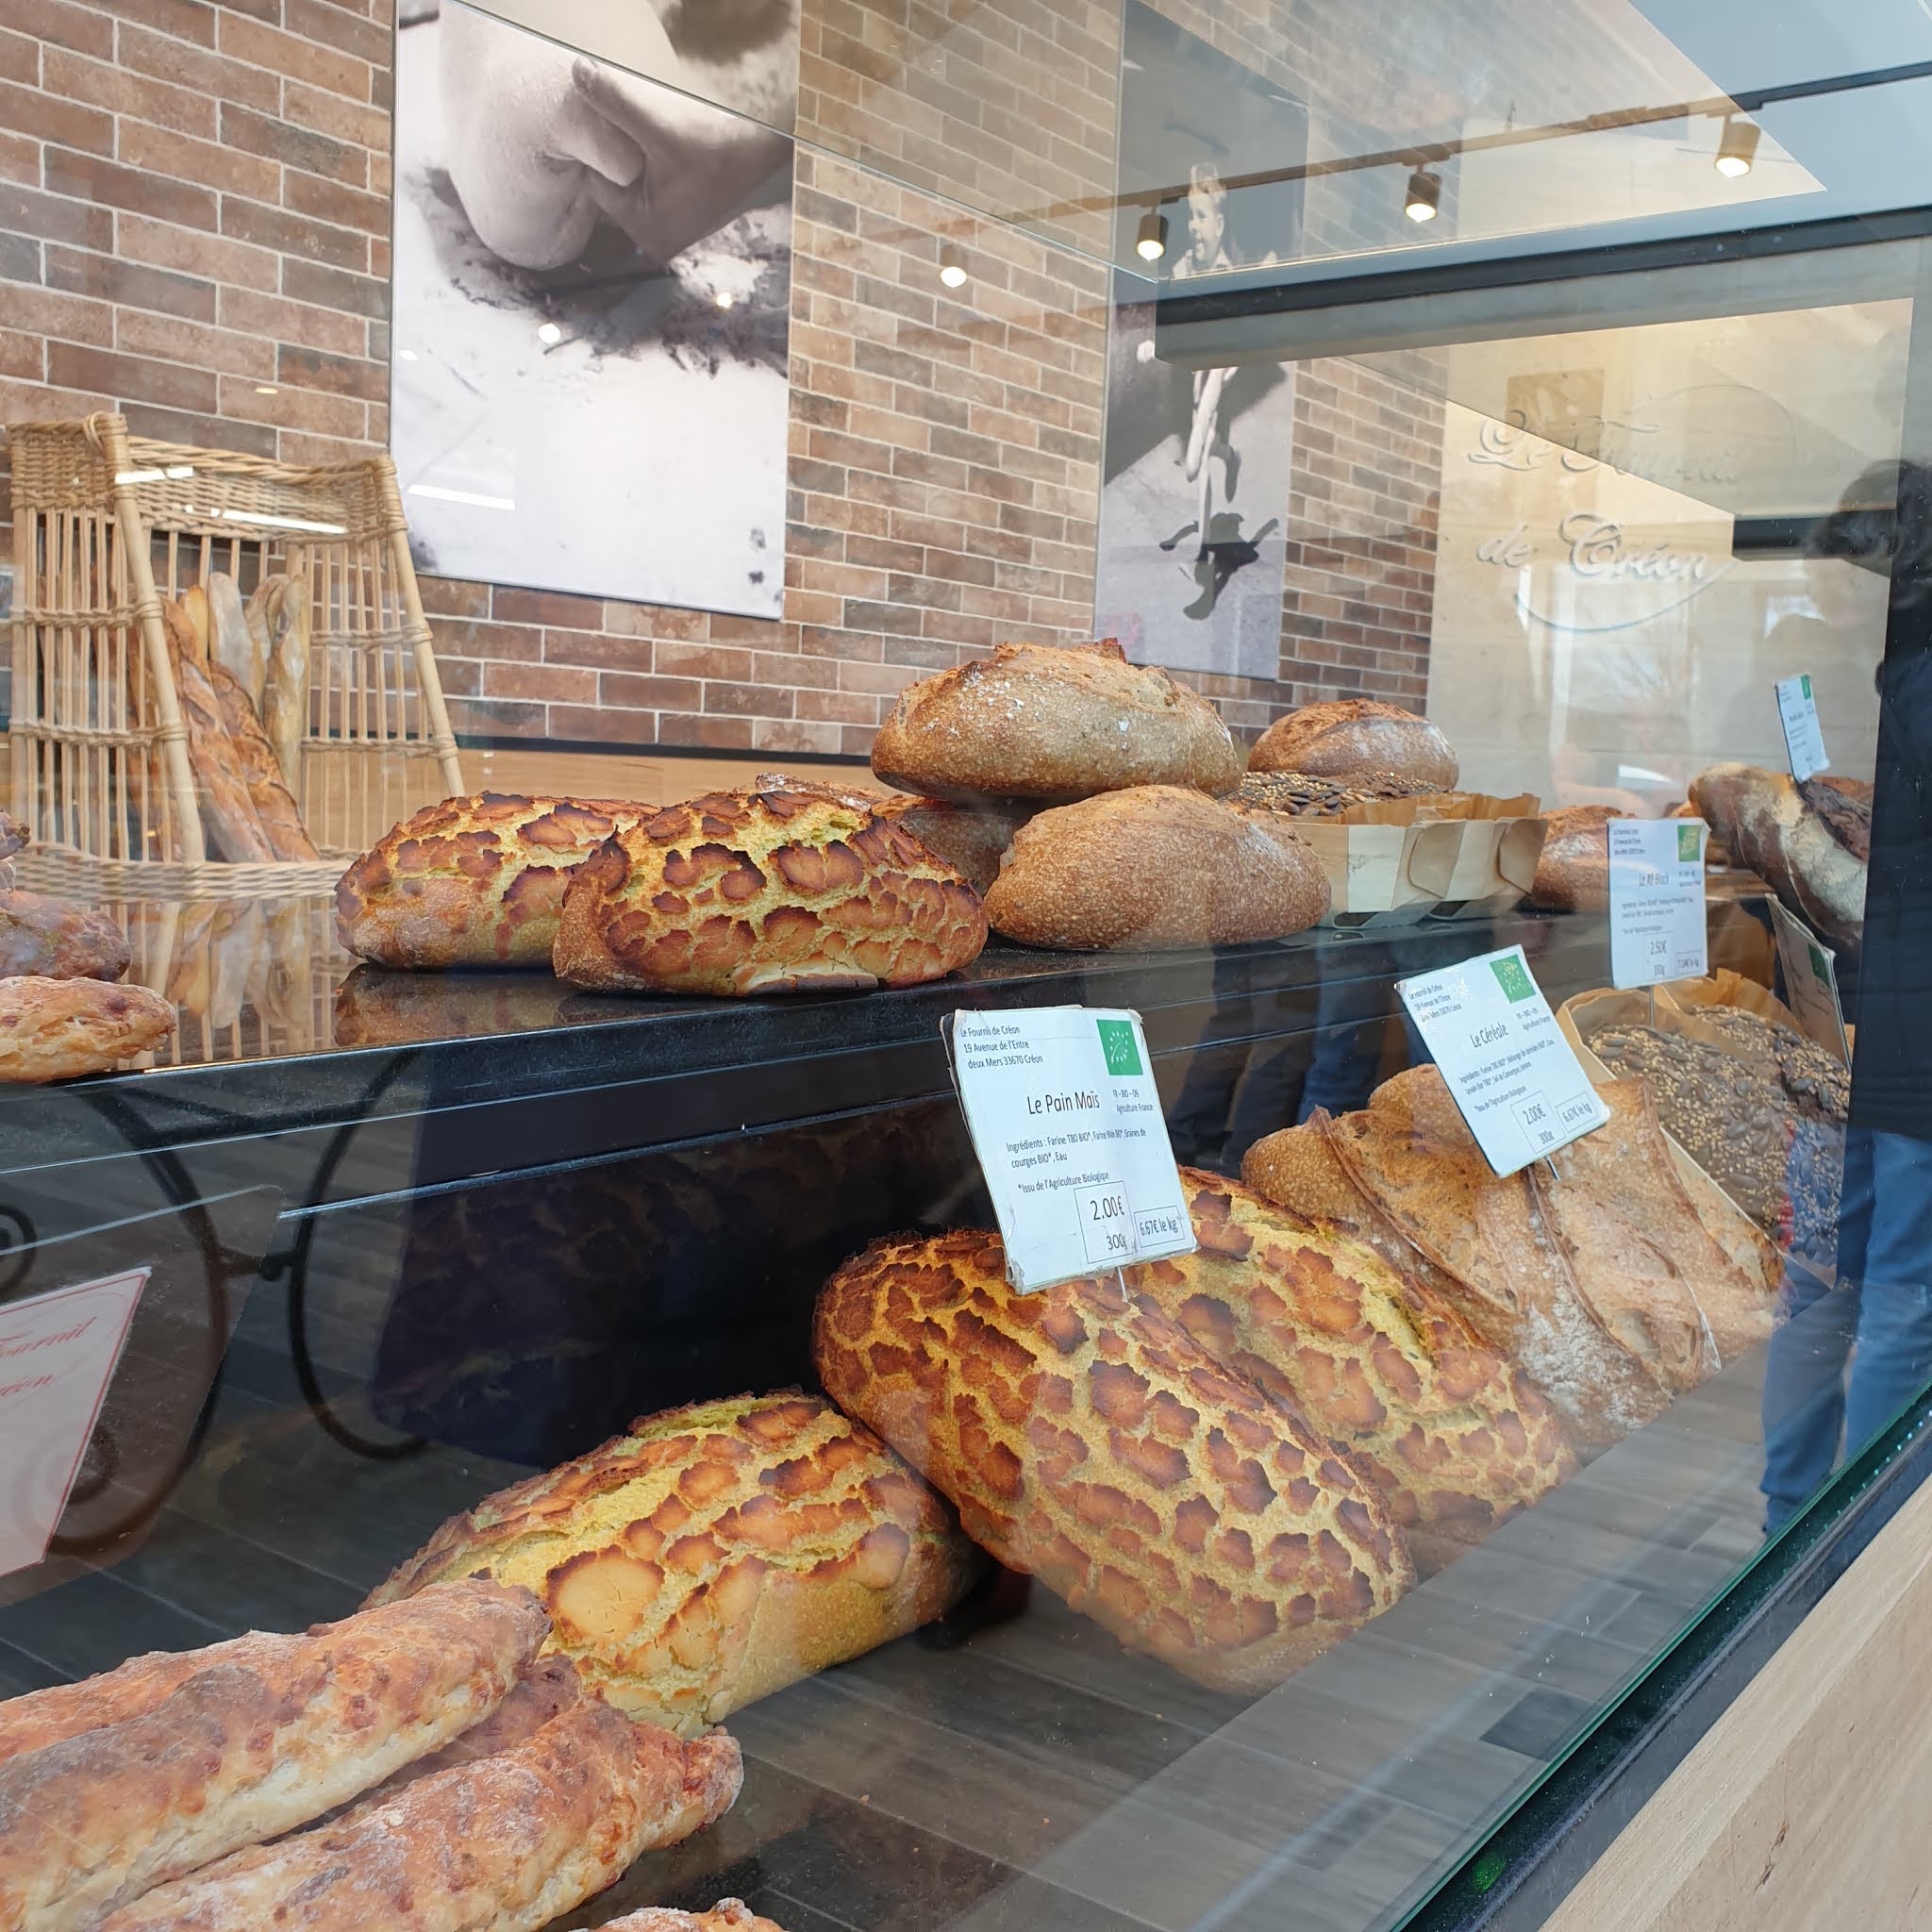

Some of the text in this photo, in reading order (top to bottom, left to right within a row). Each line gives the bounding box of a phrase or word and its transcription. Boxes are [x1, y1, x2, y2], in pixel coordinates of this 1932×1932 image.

[1476, 514, 1708, 579] de Créon
[991, 1025, 1000, 1035] de
[1001, 1024, 1021, 1035] Créon
[1469, 1022, 1508, 1048] Le Céréale
[963, 1040, 1030, 1053] 19 Avenue de l'Entre
[968, 1054, 1044, 1069] deux Mers 33670 Créon
[1026, 1091, 1100, 1115] Le Pain Maïs
[1138, 1102, 1154, 1111] France
[1522, 1103, 1546, 1125] 2.00€
[1006, 1139, 1043, 1154] Ingrédients
[1047, 1135, 1067, 1146] Farine
[1140, 1127, 1147, 1137] de
[1011, 1157, 1038, 1169] courges
[1055, 1152, 1068, 1161] Eau
[1035, 1181, 1044, 1191] de
[1081, 1171, 1110, 1184] Biologique
[1090, 1195, 1125, 1222] 2.00€
[1139, 1216, 1179, 1237] 6.67€ le kg
